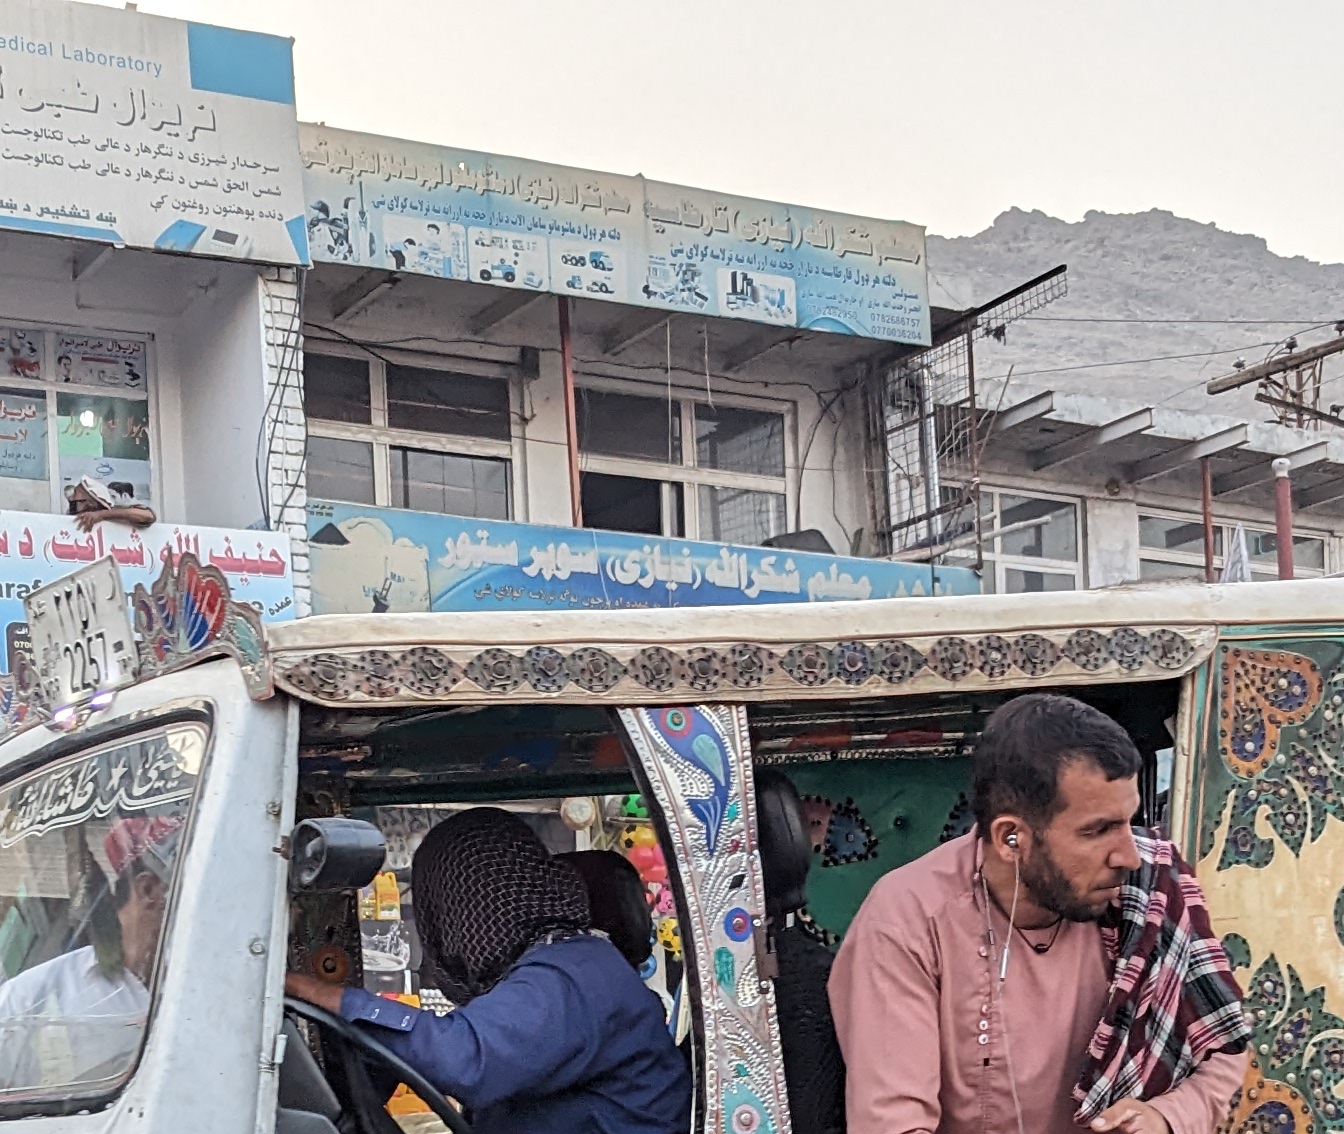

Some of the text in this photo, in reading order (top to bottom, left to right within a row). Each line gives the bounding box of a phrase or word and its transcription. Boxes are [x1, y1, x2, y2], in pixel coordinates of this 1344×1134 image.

[61, 42, 163, 79] Laboratory
[67, 131, 92, 148] طب
[67, 156, 92, 173] طب
[222, 180, 250, 196] الحق
[17, 527, 34, 559] د
[209, 534, 287, 585] حنیف
